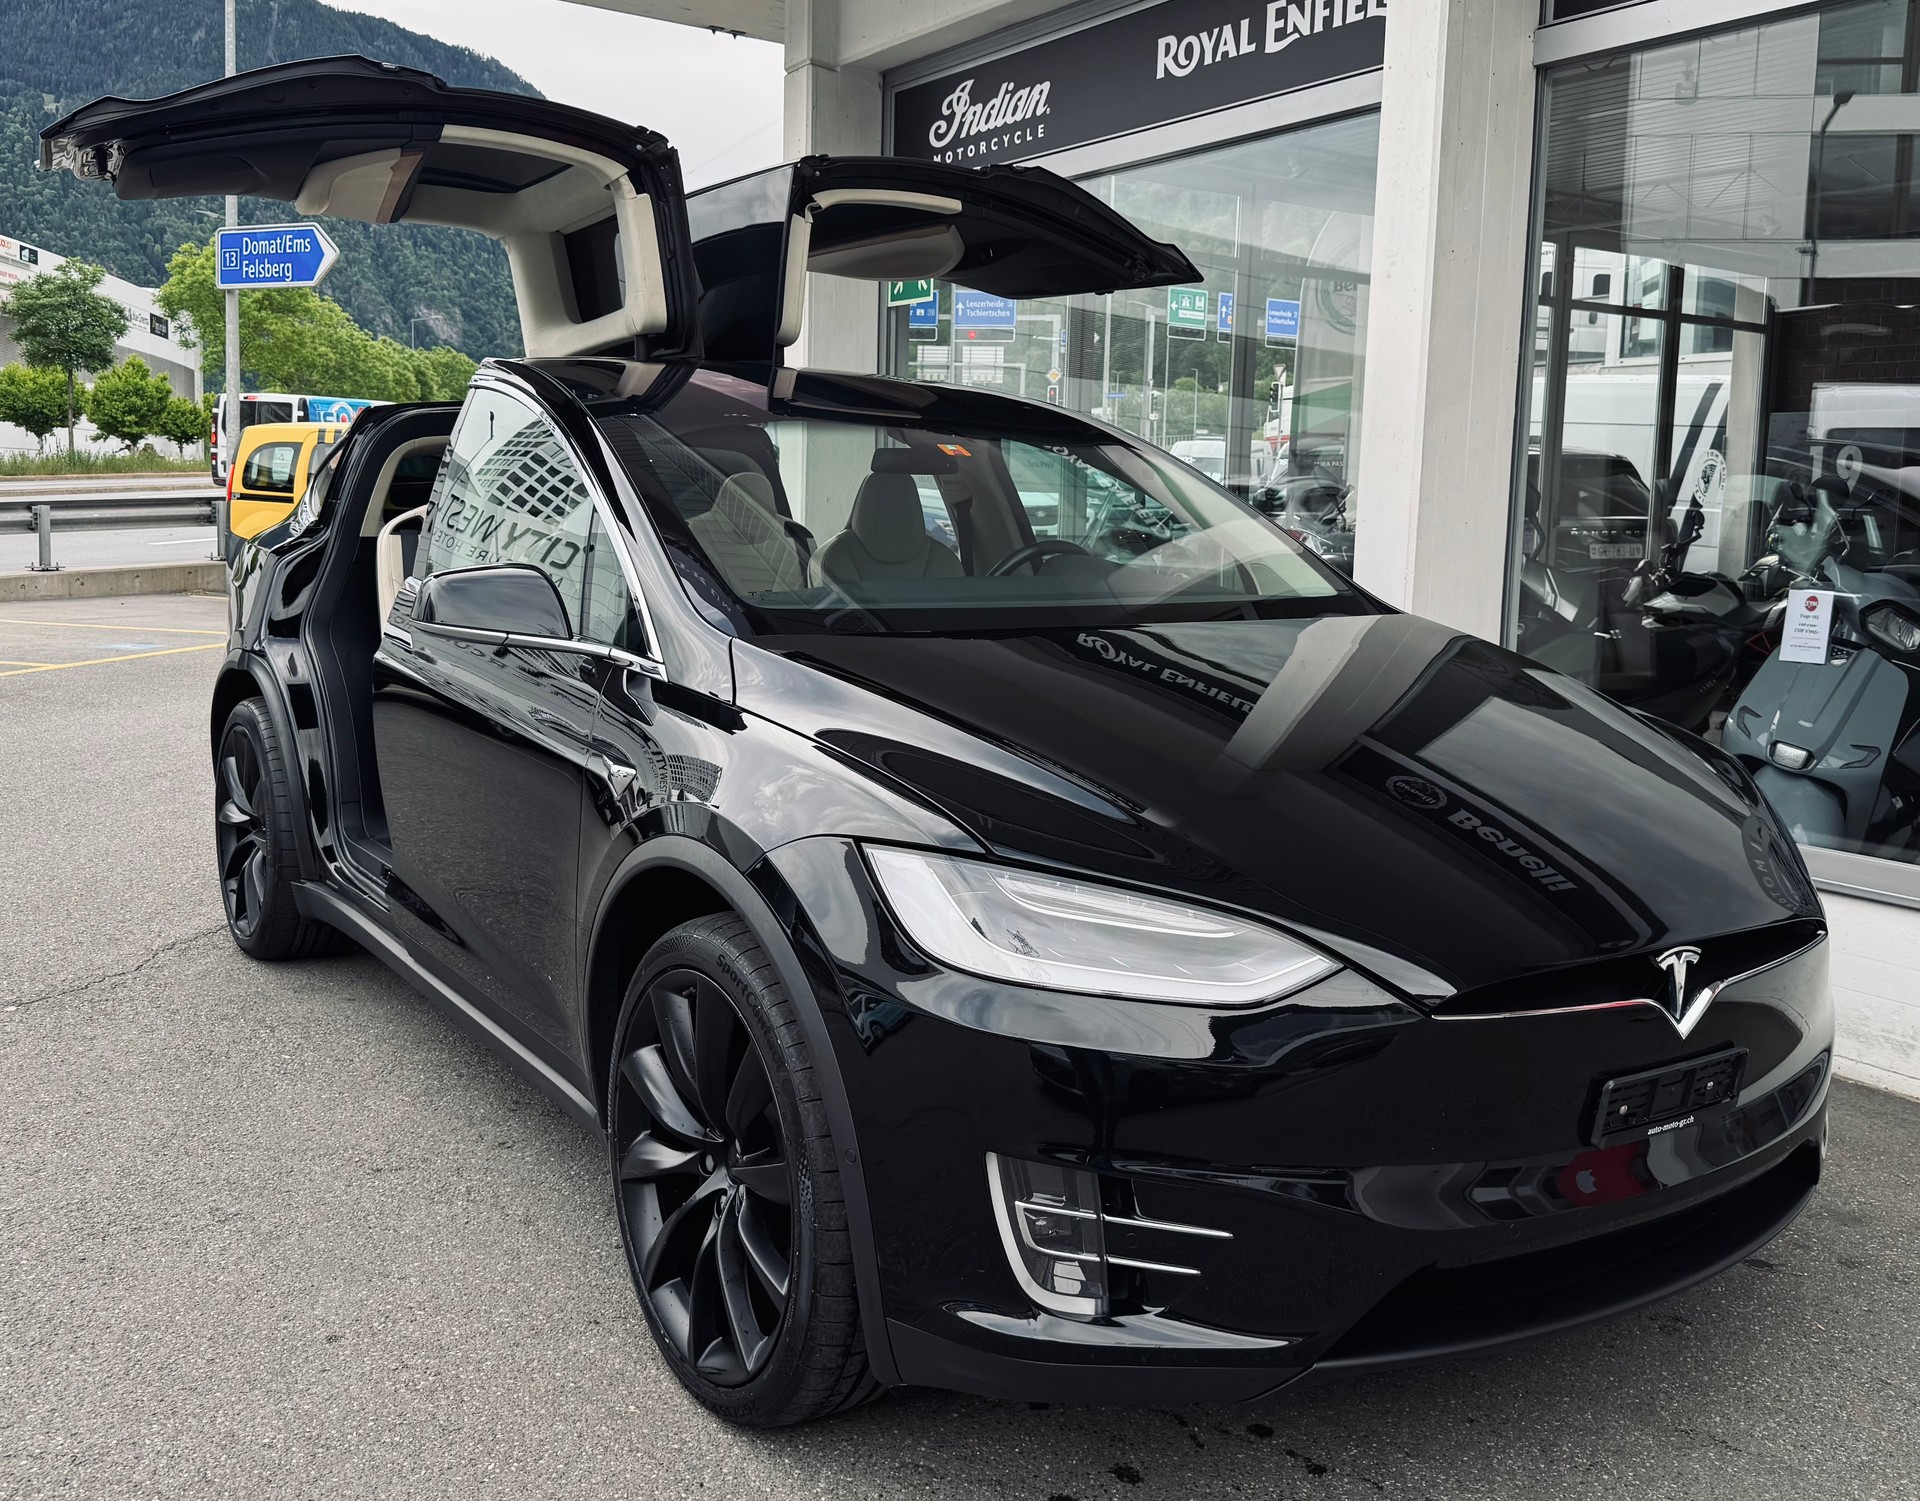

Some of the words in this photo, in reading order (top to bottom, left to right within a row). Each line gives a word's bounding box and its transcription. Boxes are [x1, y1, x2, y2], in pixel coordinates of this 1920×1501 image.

[1156, 18, 1257, 80] ROYAL
[928, 79, 1051, 148] Indian
[933, 124, 1045, 163] MOTORCYCLE
[242, 234, 311, 256] Domat/Ems
[225, 251, 237, 267] 13
[242, 258, 293, 282] Felsberg
[966, 300, 1005, 308] Lenzerheide
[966, 309, 1011, 317] Tschiertschen
